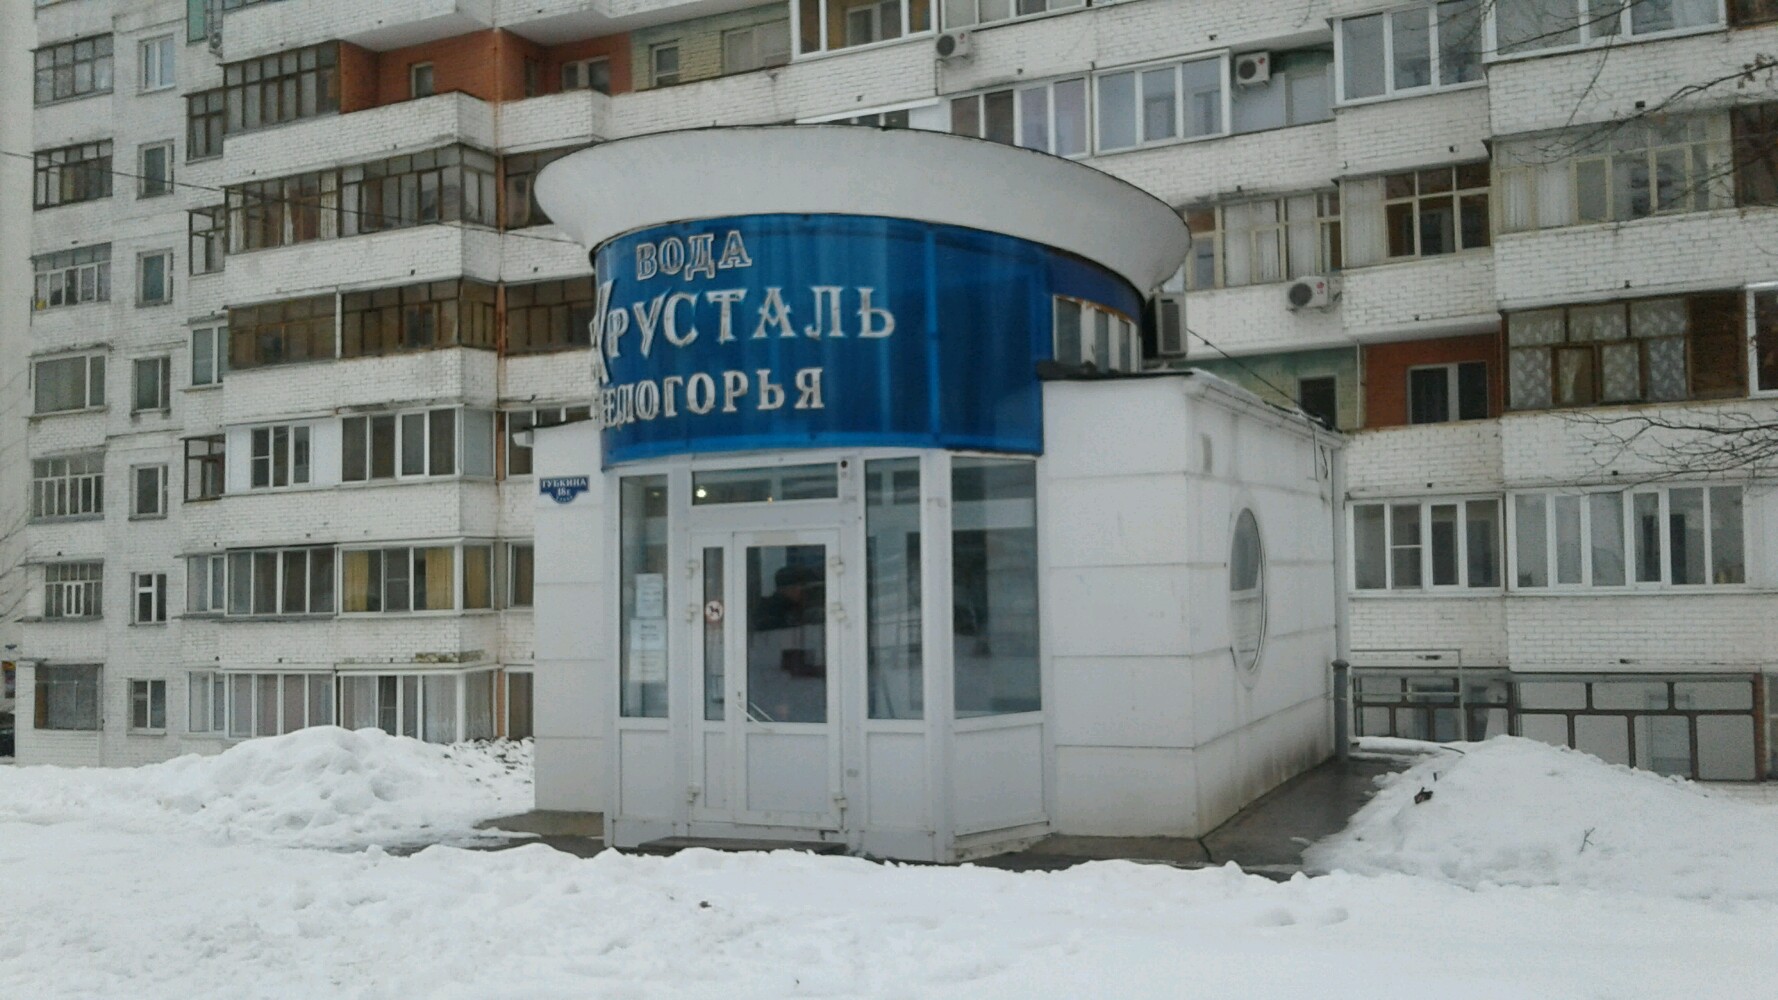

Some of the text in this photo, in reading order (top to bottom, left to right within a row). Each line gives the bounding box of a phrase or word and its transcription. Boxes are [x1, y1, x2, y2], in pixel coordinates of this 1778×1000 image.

[637, 230, 752, 281] ВОДА
[592, 367, 825, 430] ЕЛОГОРЬЯ
[542, 478, 587, 488] ГУБКИНА
